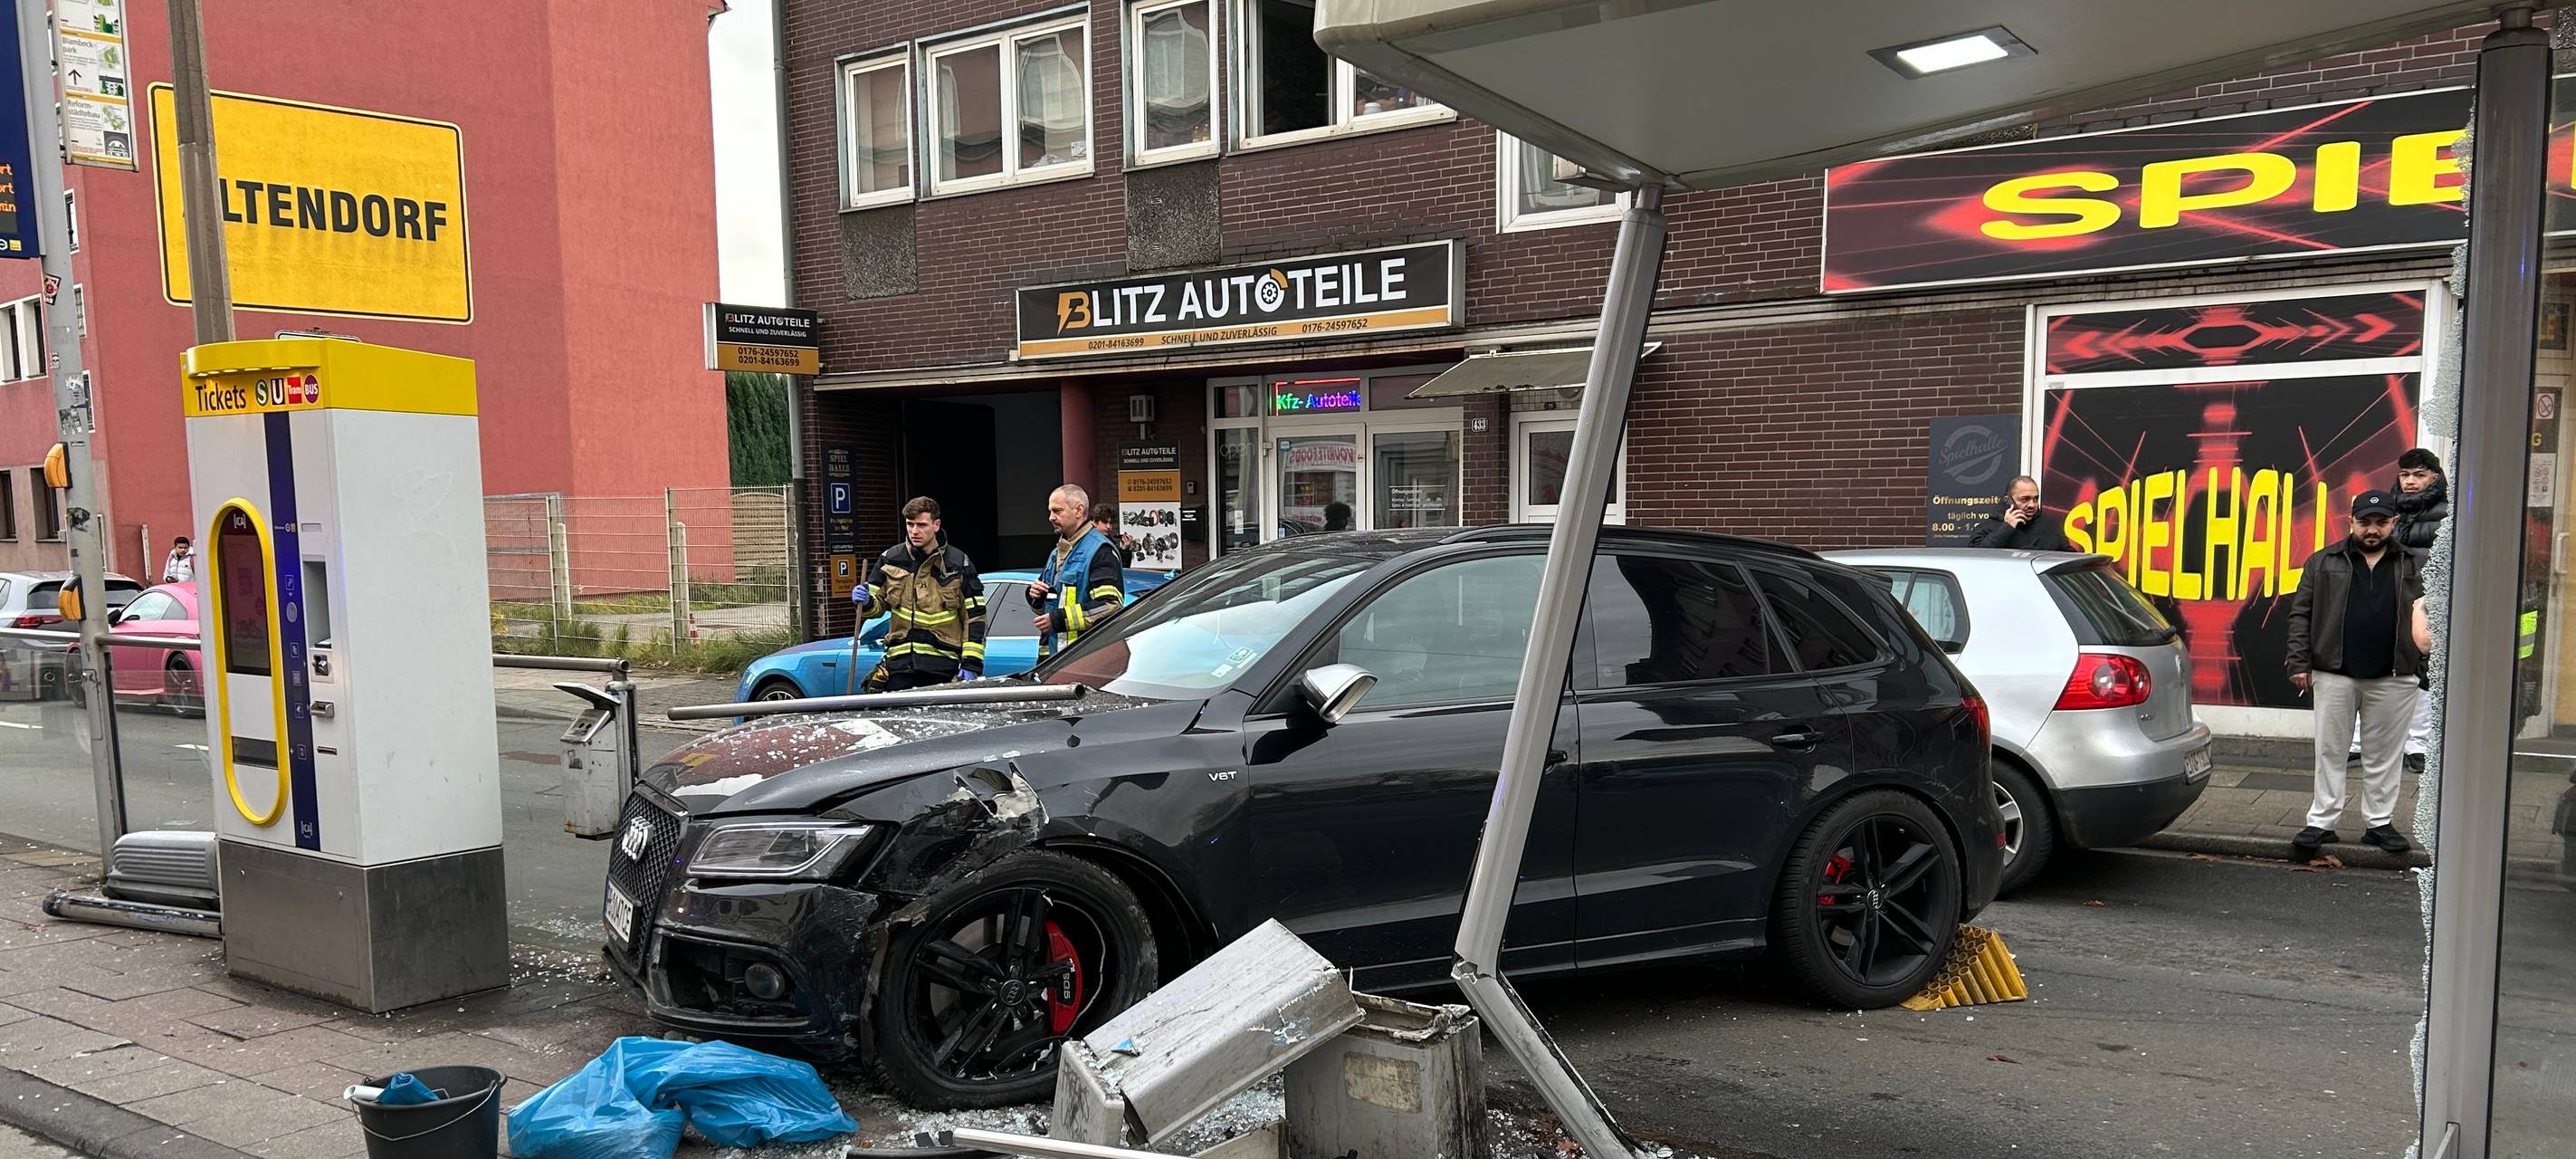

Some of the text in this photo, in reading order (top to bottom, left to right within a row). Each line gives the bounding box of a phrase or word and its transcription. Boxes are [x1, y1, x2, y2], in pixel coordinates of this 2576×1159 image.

[183, 177, 447, 242] LTENDORF
[1057, 257, 1407, 338] BLITZ AUTOTEILE
[725, 312, 811, 328] BLITZ AUTOTEILE
[728, 326, 755, 334] SCHNELL
[769, 329, 807, 338] ZUVERLÄSSIG
[1088, 319, 1368, 350] 0201-84163699 SCHNELL UND ZUVERLÄSSIG 0176-24597652
[738, 347, 798, 358] 0176-24597652
[738, 356, 800, 367] 0201-84163699
[196, 378, 319, 411] Tickets S U Tram BUS
[1473, 419, 1487, 431] 433
[1141, 446, 1177, 455] AUTOTEILE
[1939, 434, 2008, 466] Spielhalle
[829, 455, 848, 464] SPIEL
[835, 487, 845, 510] P
[1932, 494, 2000, 506] Öffnungszeit
[1948, 511, 1989, 522] täglich vo
[1932, 522, 1955, 532] 8.00
[1208, 771, 1237, 781] V6T
